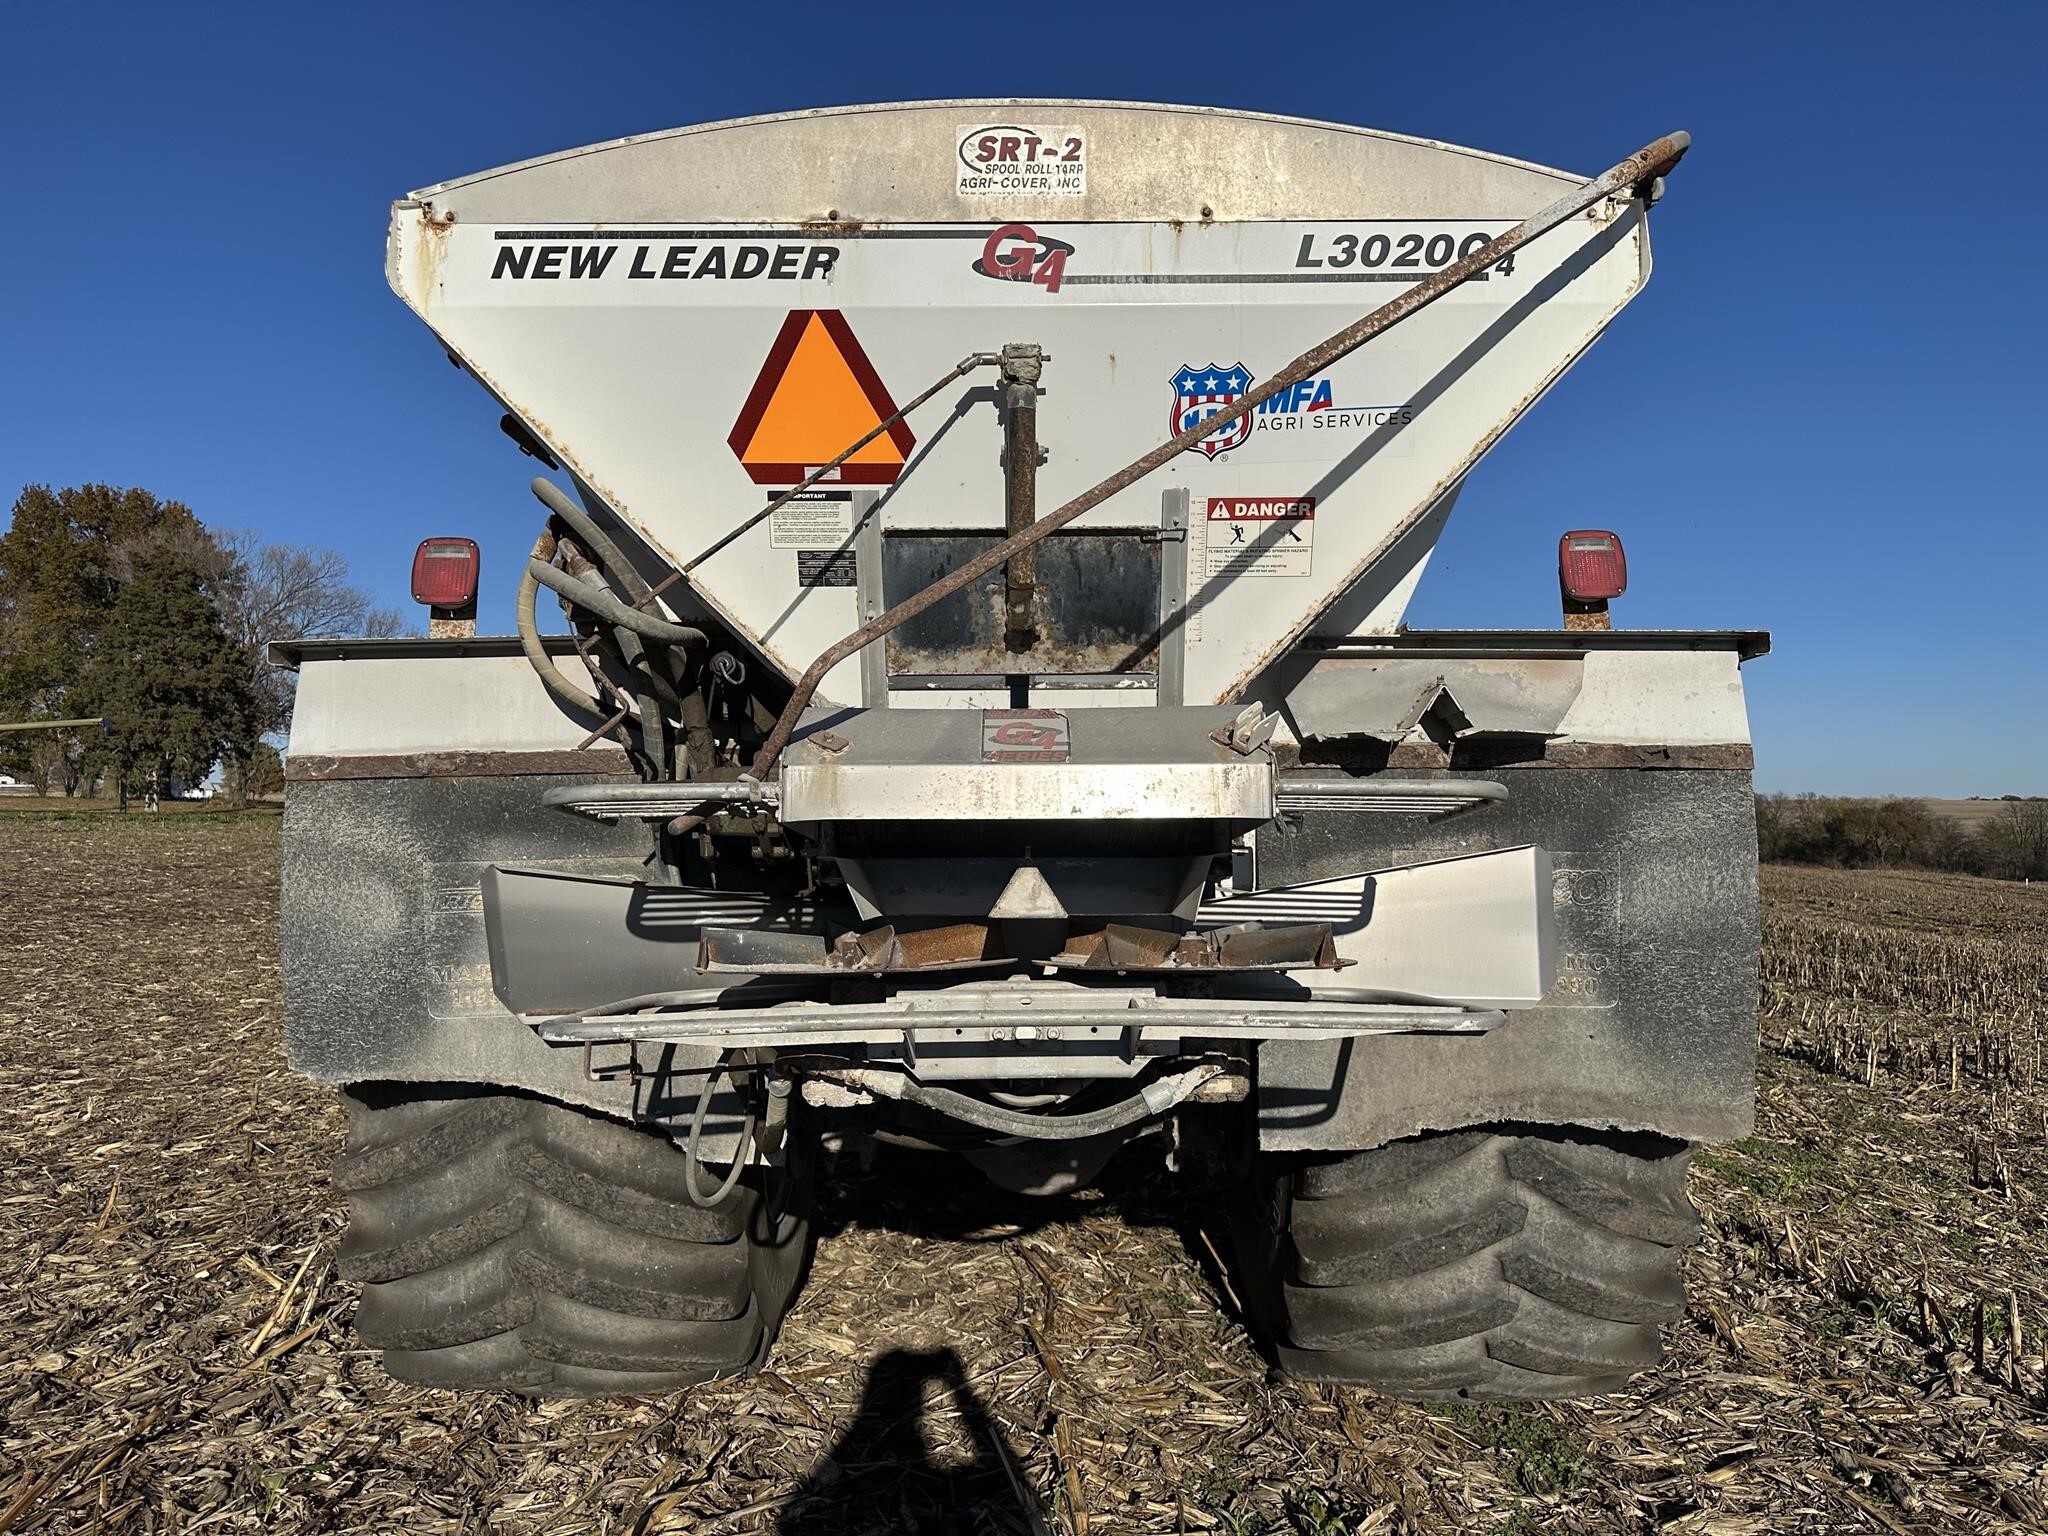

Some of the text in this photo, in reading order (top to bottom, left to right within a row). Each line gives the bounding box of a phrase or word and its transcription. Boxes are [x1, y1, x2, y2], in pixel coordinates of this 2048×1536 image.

[975, 136, 1082, 162] SRT-2
[985, 164, 1020, 174] SPOOL
[1025, 164, 1051, 174] ROLL
[491, 246, 840, 279] NEW LEADER
[983, 224, 1067, 293] G4
[1258, 379, 1333, 414] MFA
[1184, 409, 1237, 435] MA
[1257, 411, 1412, 431] AGRI SERVICES
[1235, 502, 1311, 516] DANGER
[996, 721, 1057, 749] G4
